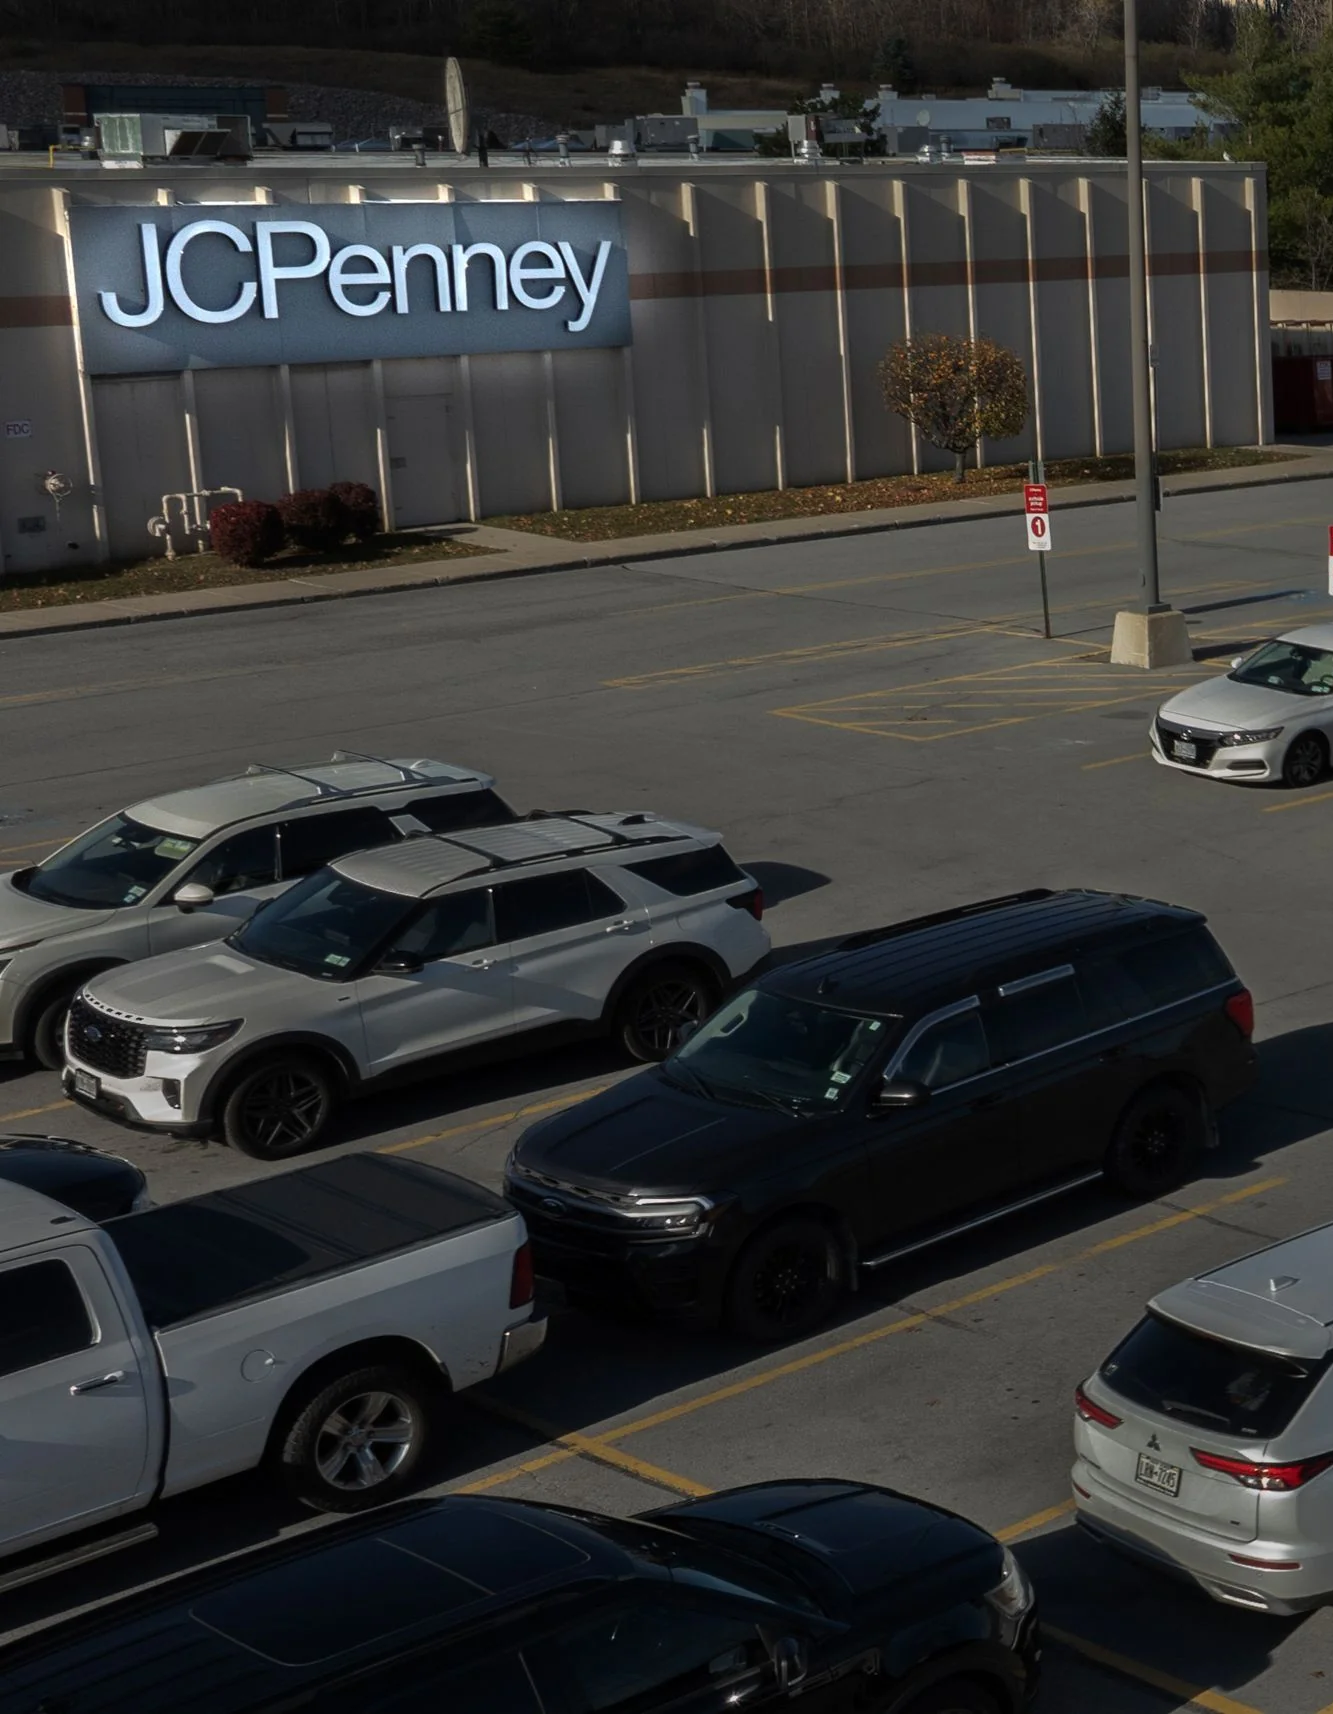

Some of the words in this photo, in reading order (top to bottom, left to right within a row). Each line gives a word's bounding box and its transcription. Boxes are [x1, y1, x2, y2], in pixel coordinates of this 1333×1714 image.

[99, 218, 613, 333] JCPenney
[6, 423, 29, 435] FDC
[1035, 519, 1042, 536] 1
[84, 993, 145, 1021] EXPLORER
